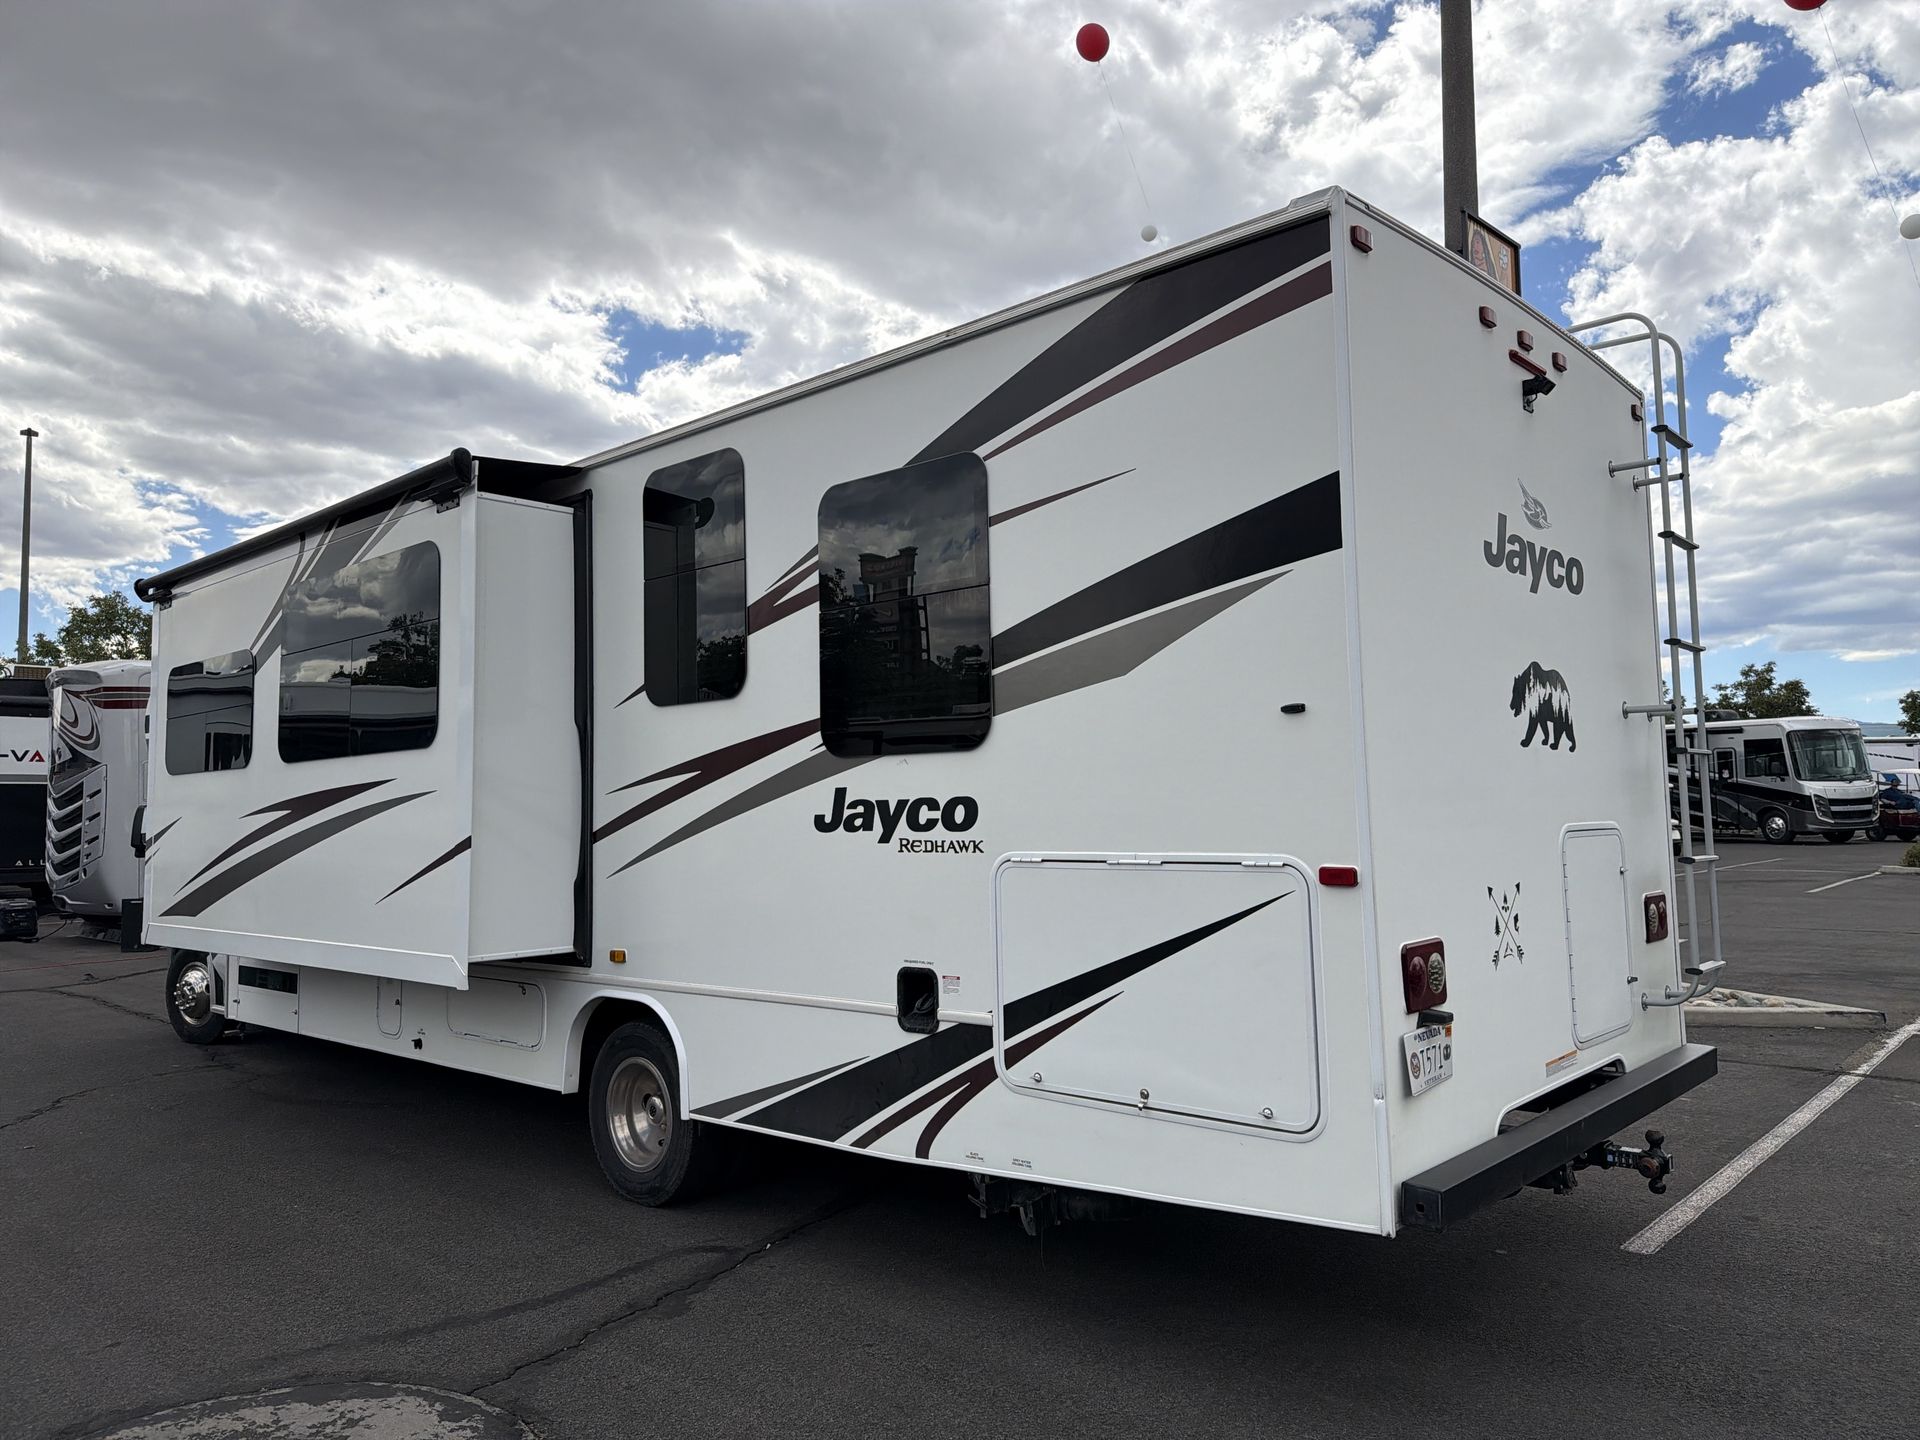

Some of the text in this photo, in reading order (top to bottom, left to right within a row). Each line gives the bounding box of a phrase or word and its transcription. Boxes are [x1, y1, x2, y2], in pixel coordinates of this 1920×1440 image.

[1483, 512, 1584, 596] Jayco
[813, 786, 979, 844] Jayco
[1417, 1026, 1442, 1043] NEVADA
[1419, 1042, 1444, 1077] T571
